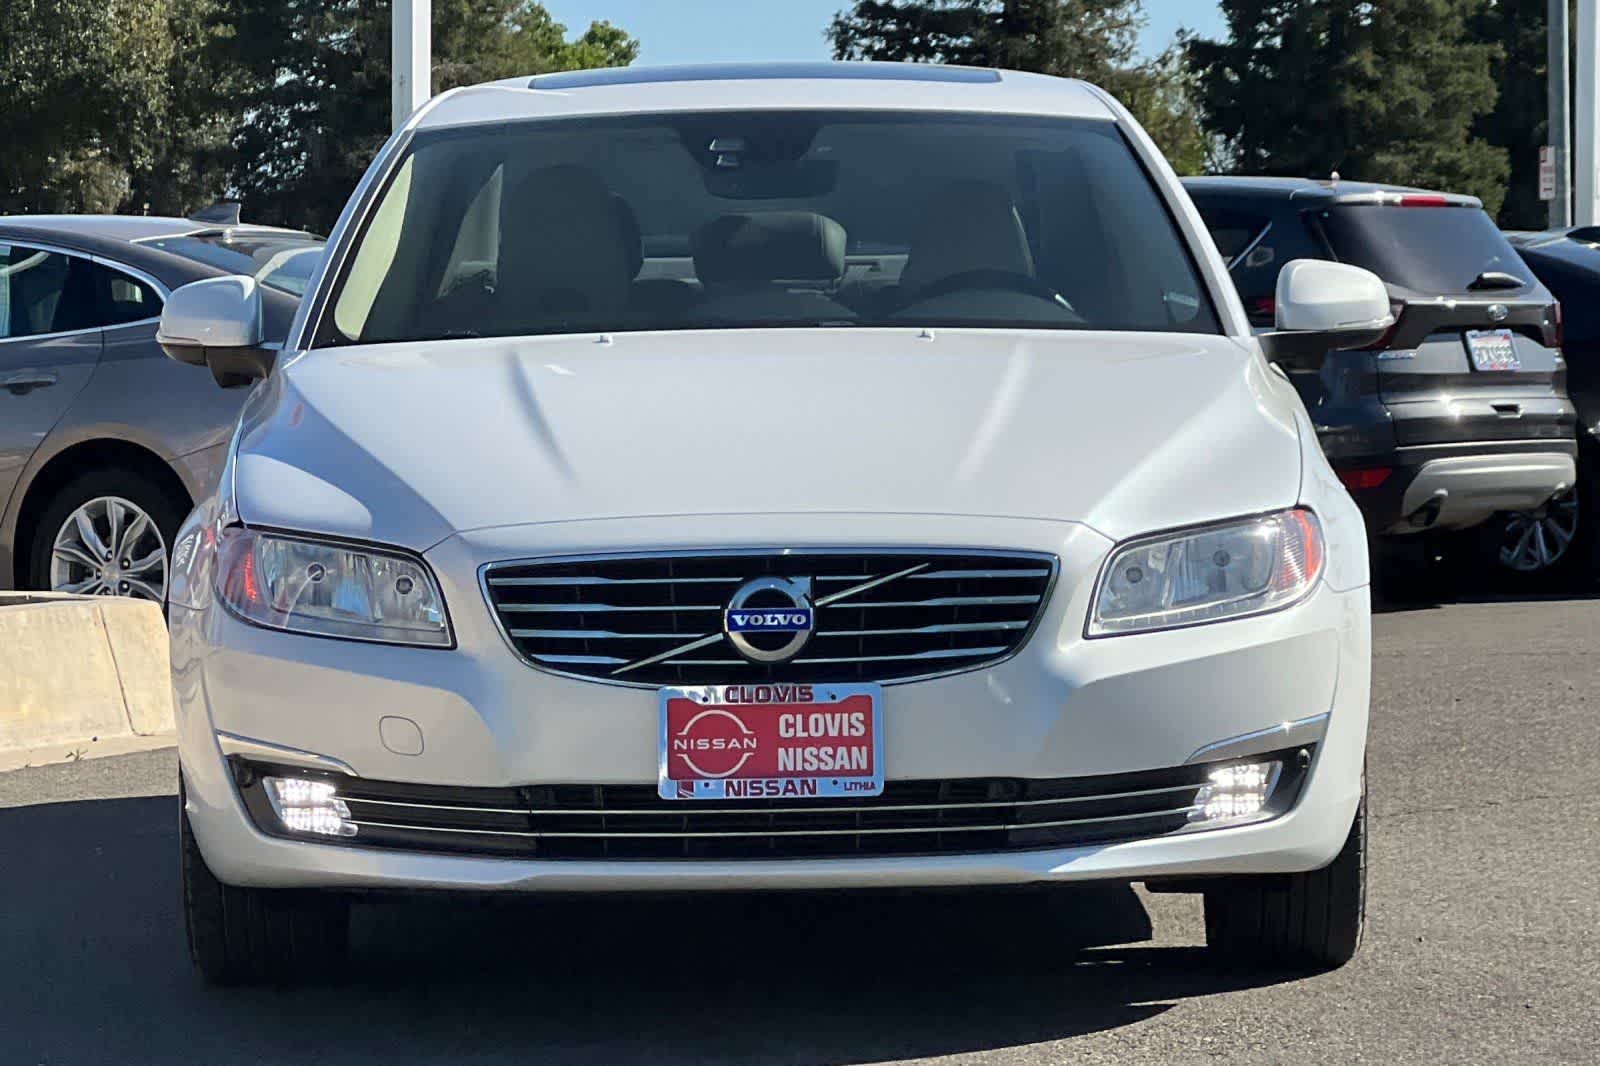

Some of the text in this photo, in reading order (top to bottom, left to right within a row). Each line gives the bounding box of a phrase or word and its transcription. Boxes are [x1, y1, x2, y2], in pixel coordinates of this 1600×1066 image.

[732, 614, 807, 626] VOLVO
[725, 686, 814, 704] CLOVIS
[779, 712, 865, 738] CLOVIS
[674, 738, 757, 750] NISSAN
[778, 746, 867, 771] NISSAN
[725, 779, 817, 797] NISSAN
[844, 781, 876, 791] LITHIA
